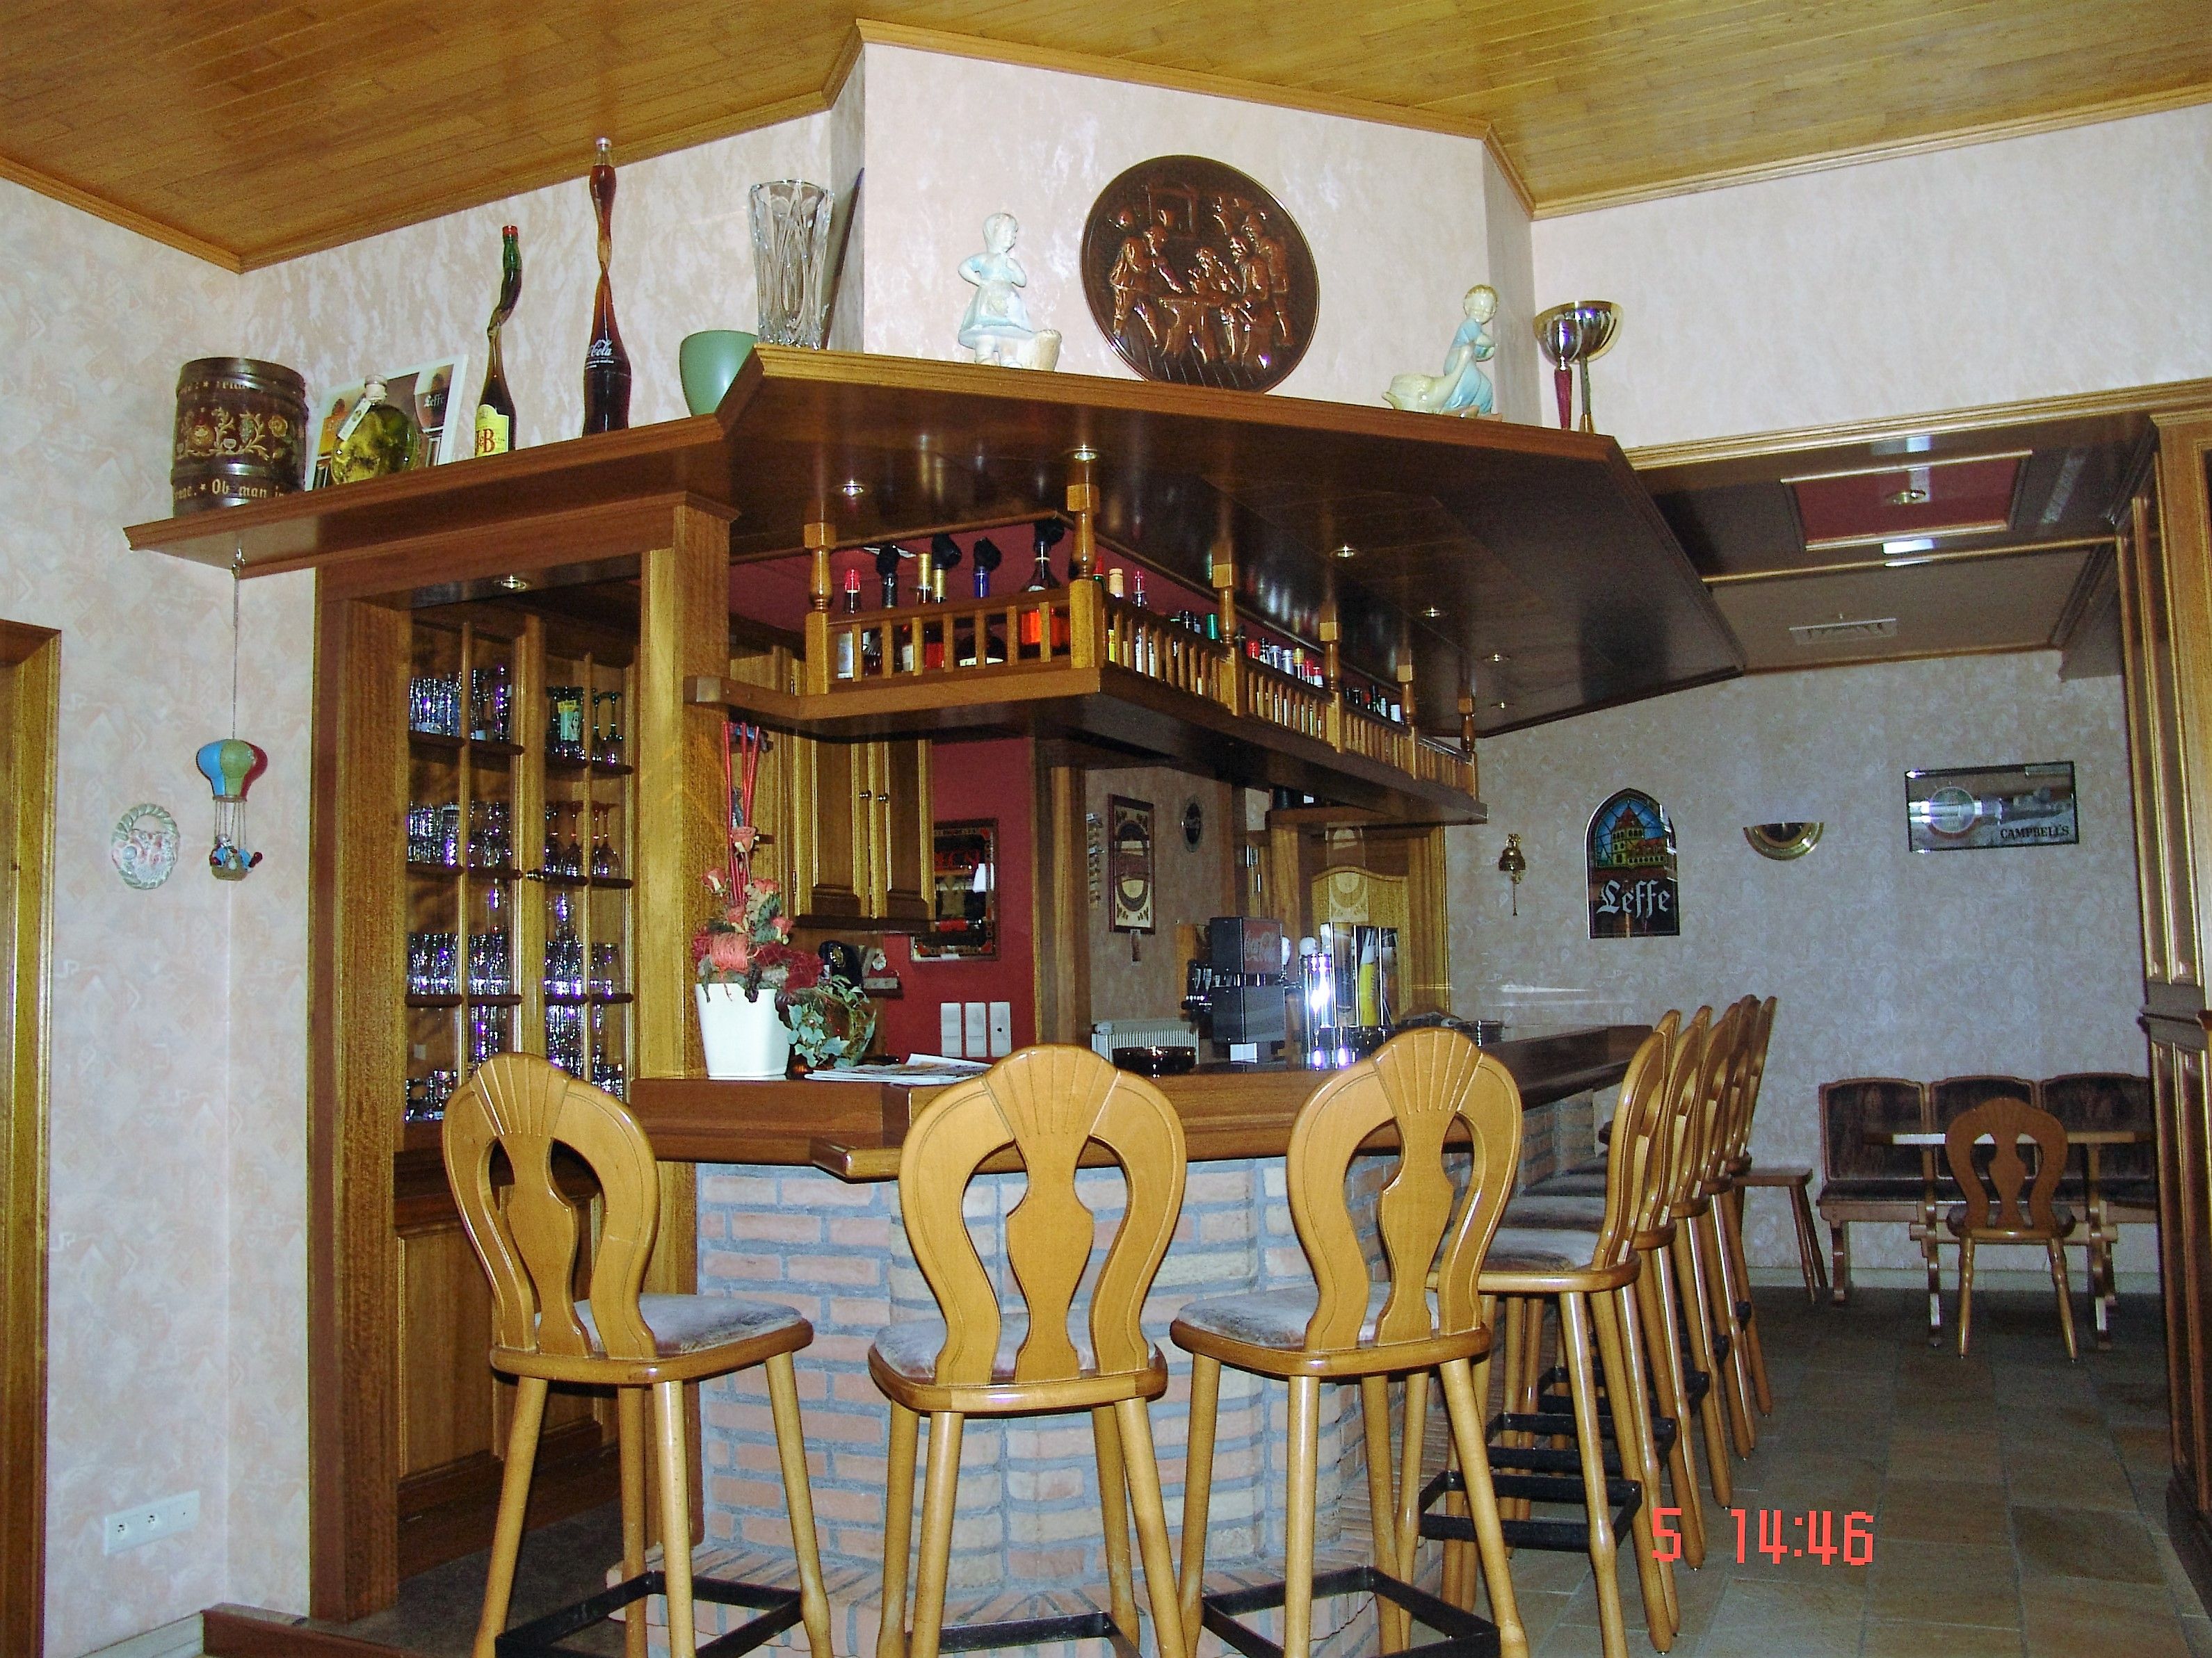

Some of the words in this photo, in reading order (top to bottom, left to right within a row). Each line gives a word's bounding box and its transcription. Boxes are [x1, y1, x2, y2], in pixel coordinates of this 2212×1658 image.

[239, 487, 267, 498] man
[2000, 824, 2069, 840] CAMPBELL'S
[1596, 879, 1670, 918] Leffe
